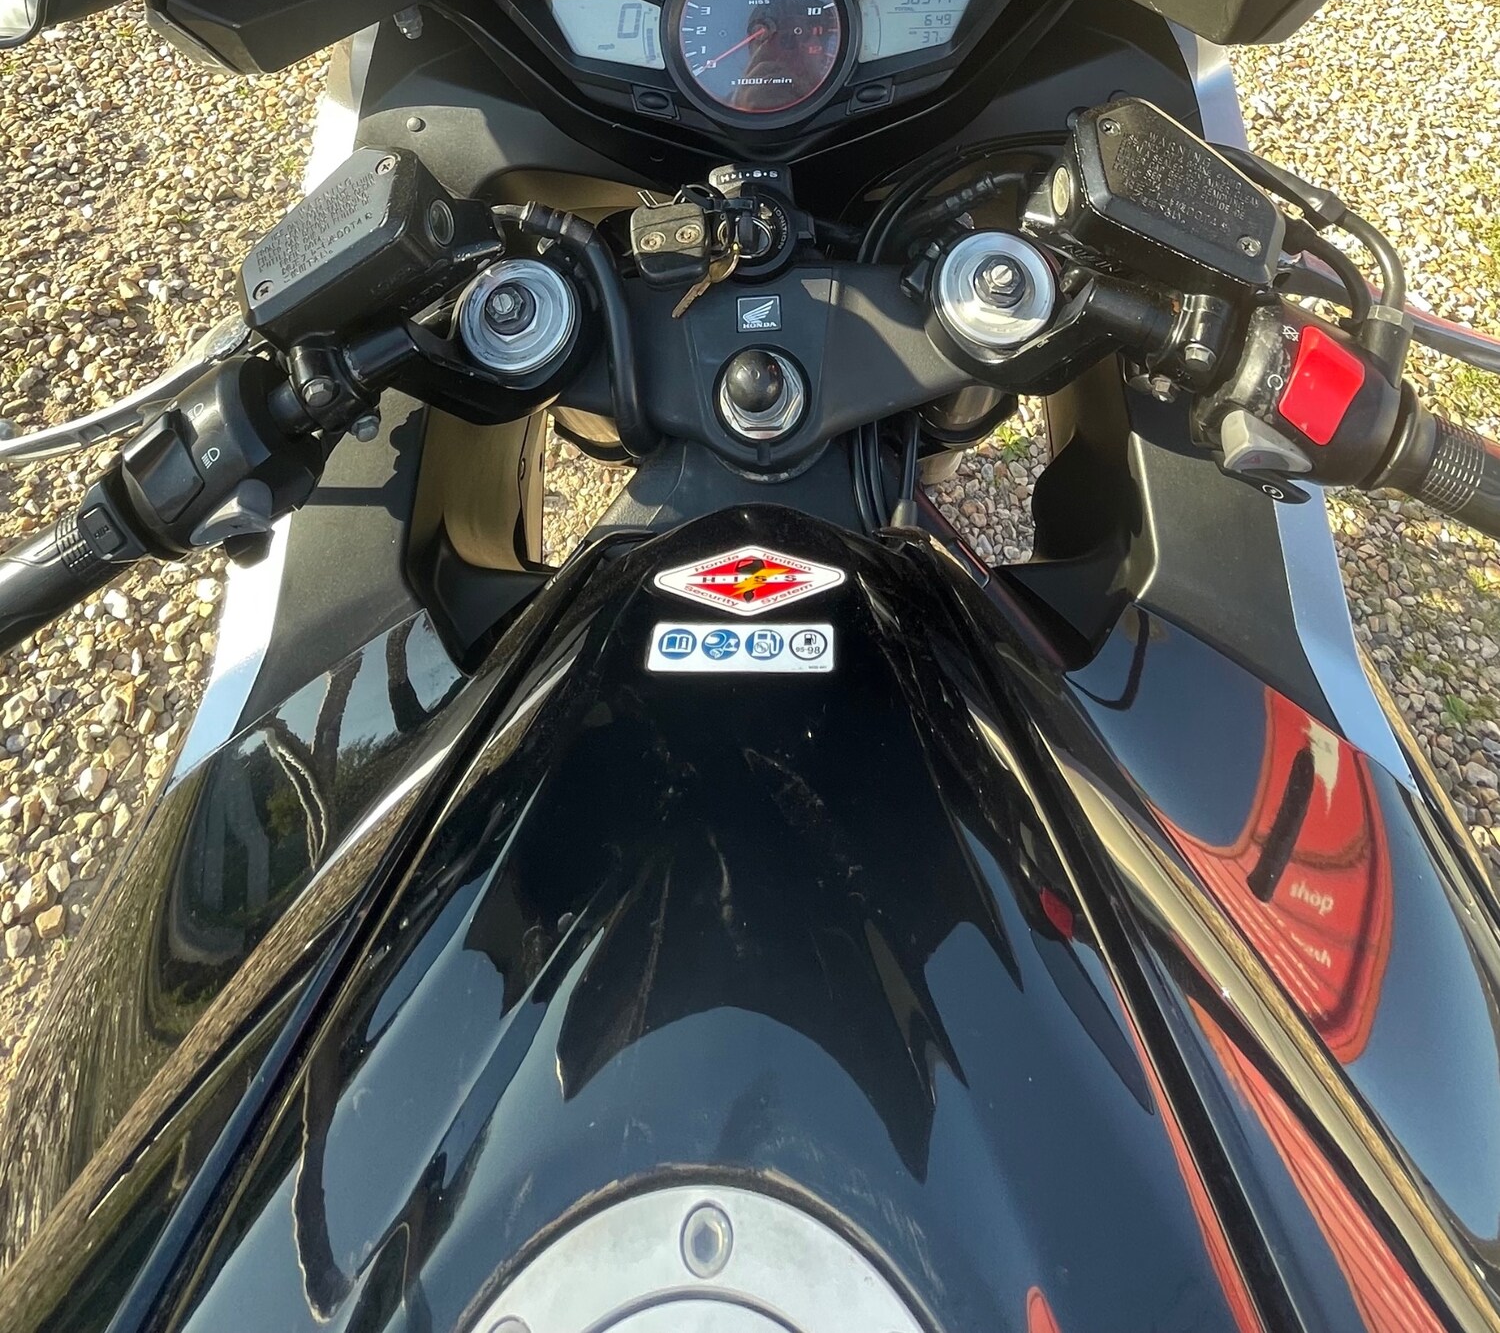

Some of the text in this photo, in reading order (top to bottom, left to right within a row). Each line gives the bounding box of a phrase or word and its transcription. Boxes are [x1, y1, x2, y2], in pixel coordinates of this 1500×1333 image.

[700, 6, 711, 15] 3
[807, 7, 822, 16] 10
[617, 3, 643, 39] 0
[696, 26, 707, 35] 2
[700, 45, 706, 54] 1
[742, 321, 777, 329] HONDA
[694, 553, 812, 573] Honda Ignition
[683, 583, 813, 607] Security System
[795, 646, 821, 654] 95-98
[1289, 880, 1335, 917] shop
